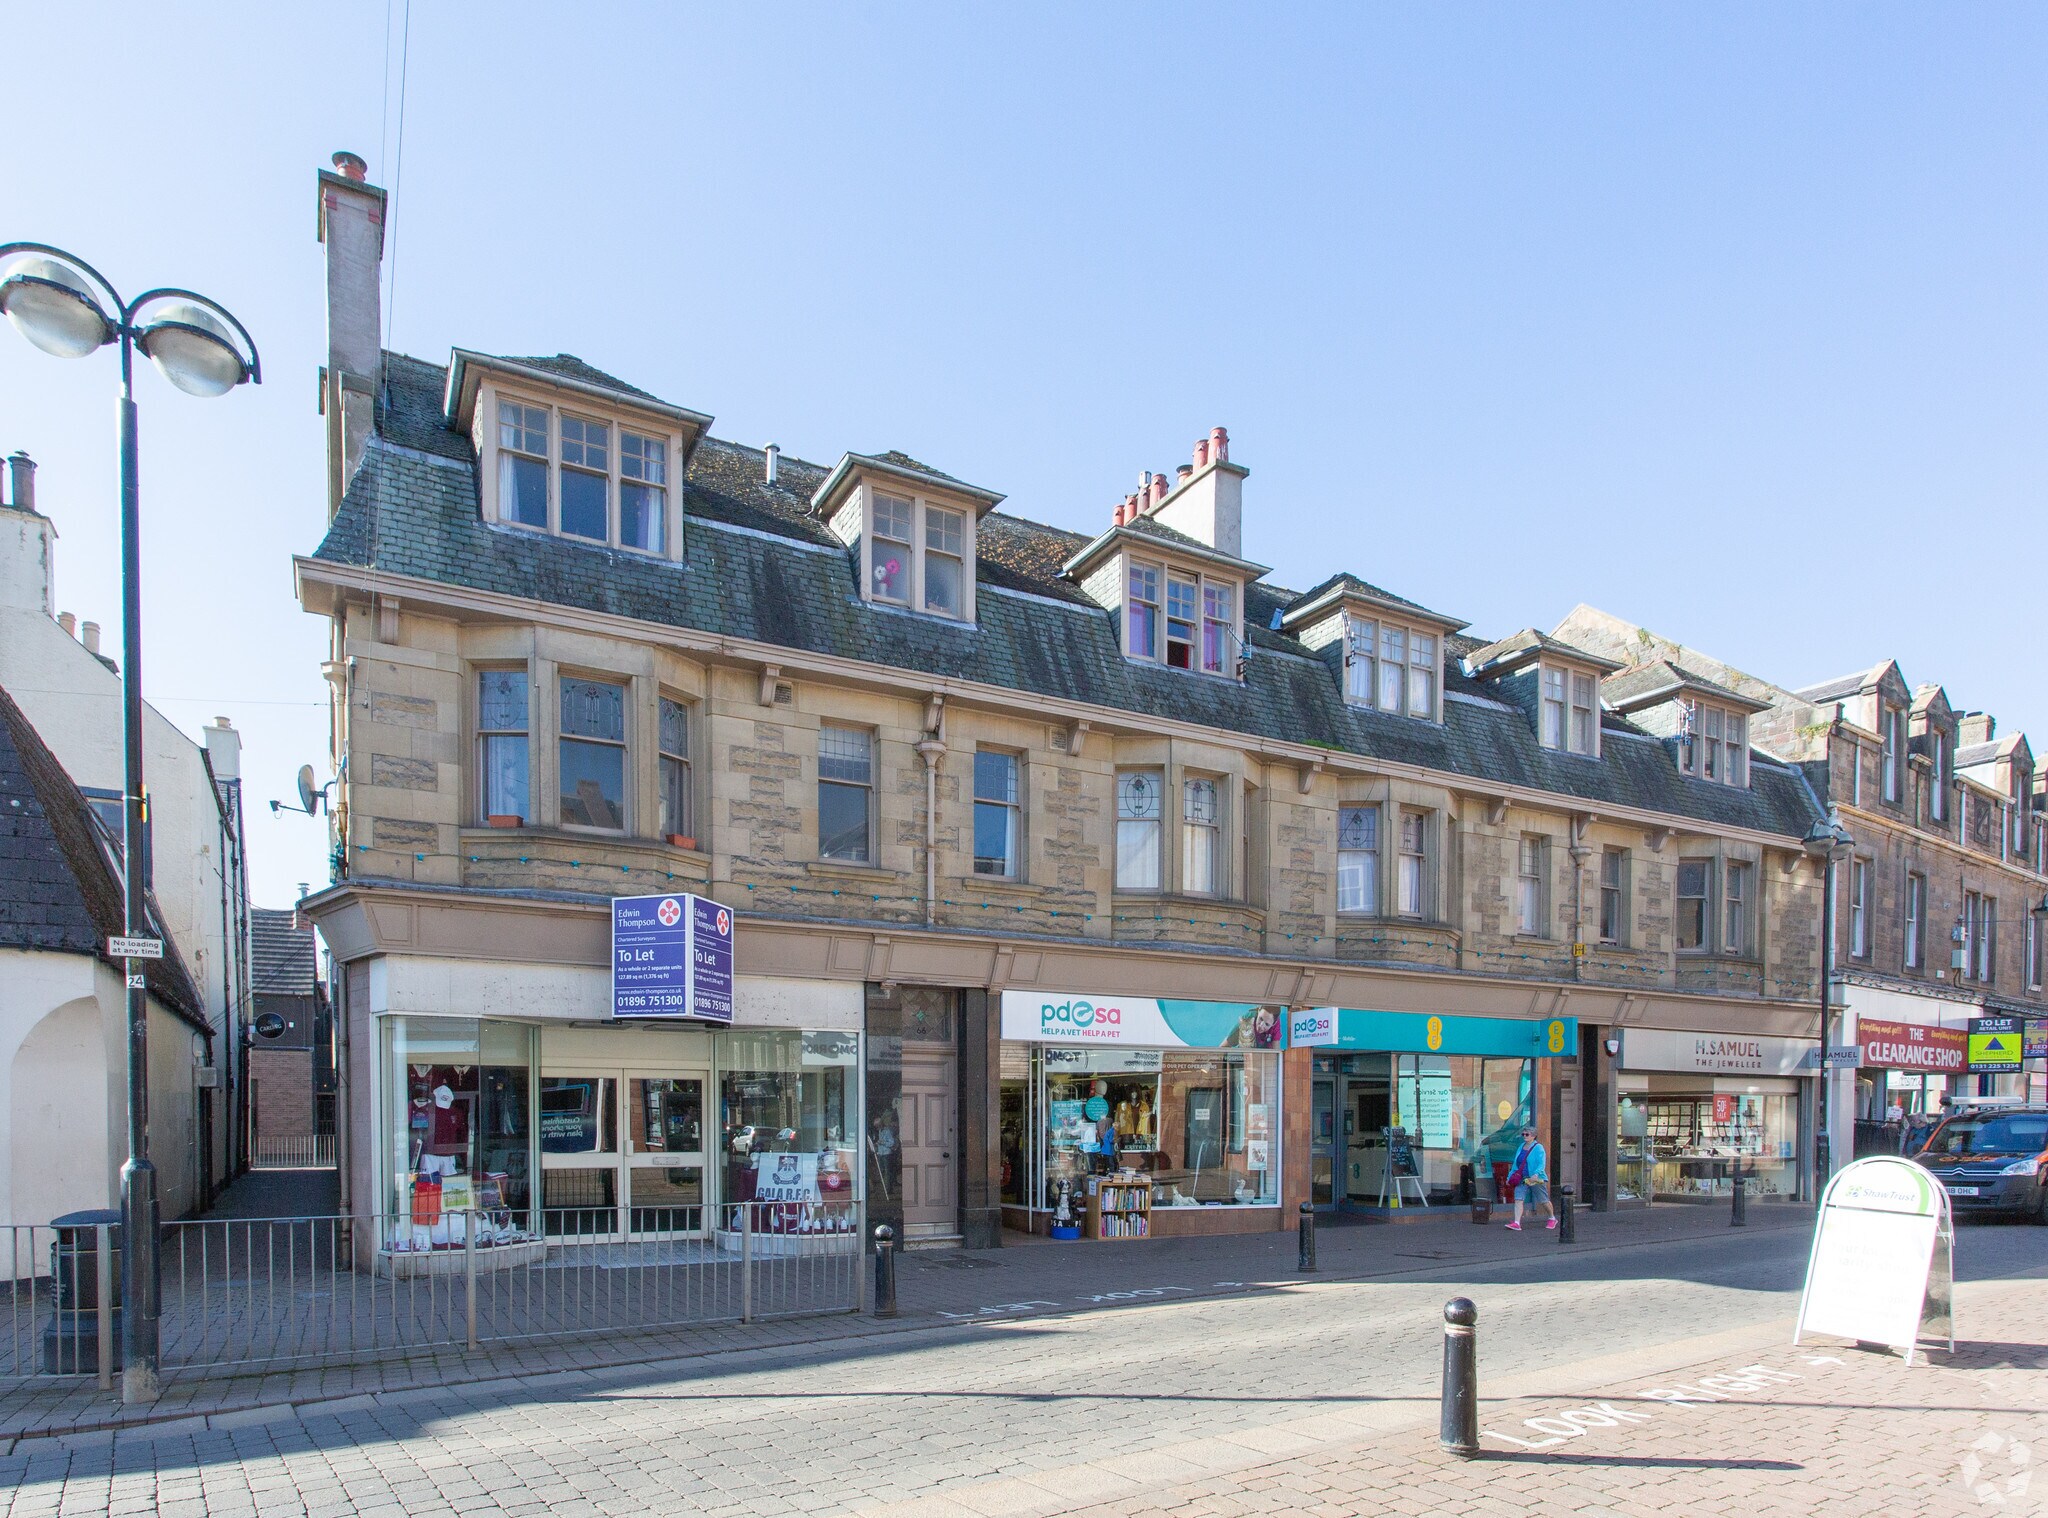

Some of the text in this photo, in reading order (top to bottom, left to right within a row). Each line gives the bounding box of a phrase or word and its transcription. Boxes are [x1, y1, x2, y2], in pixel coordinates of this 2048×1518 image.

[618, 909, 640, 918] Edwin
[694, 908, 708, 920] Edwin
[618, 918, 656, 929] Thompson
[694, 918, 716, 932] Thompson
[128, 940, 158, 948] loading
[618, 949, 654, 962] To Let
[694, 948, 716, 966] To Let
[128, 976, 144, 988] 24
[618, 996, 683, 1006] 01896 751300
[694, 996, 730, 1012] 01896 751300
[1910, 1028, 1924, 1040] THE
[1868, 1042, 1962, 1068] CLEARANCE SHOP
[1717, 1060, 1762, 1068] JEWELLER
[1075, 1286, 1193, 1302] LOOK
[936, 1300, 1062, 1318] LEFT
[1636, 1364, 1806, 1408] RIGHT
[1482, 1402, 1652, 1448] LOOK
